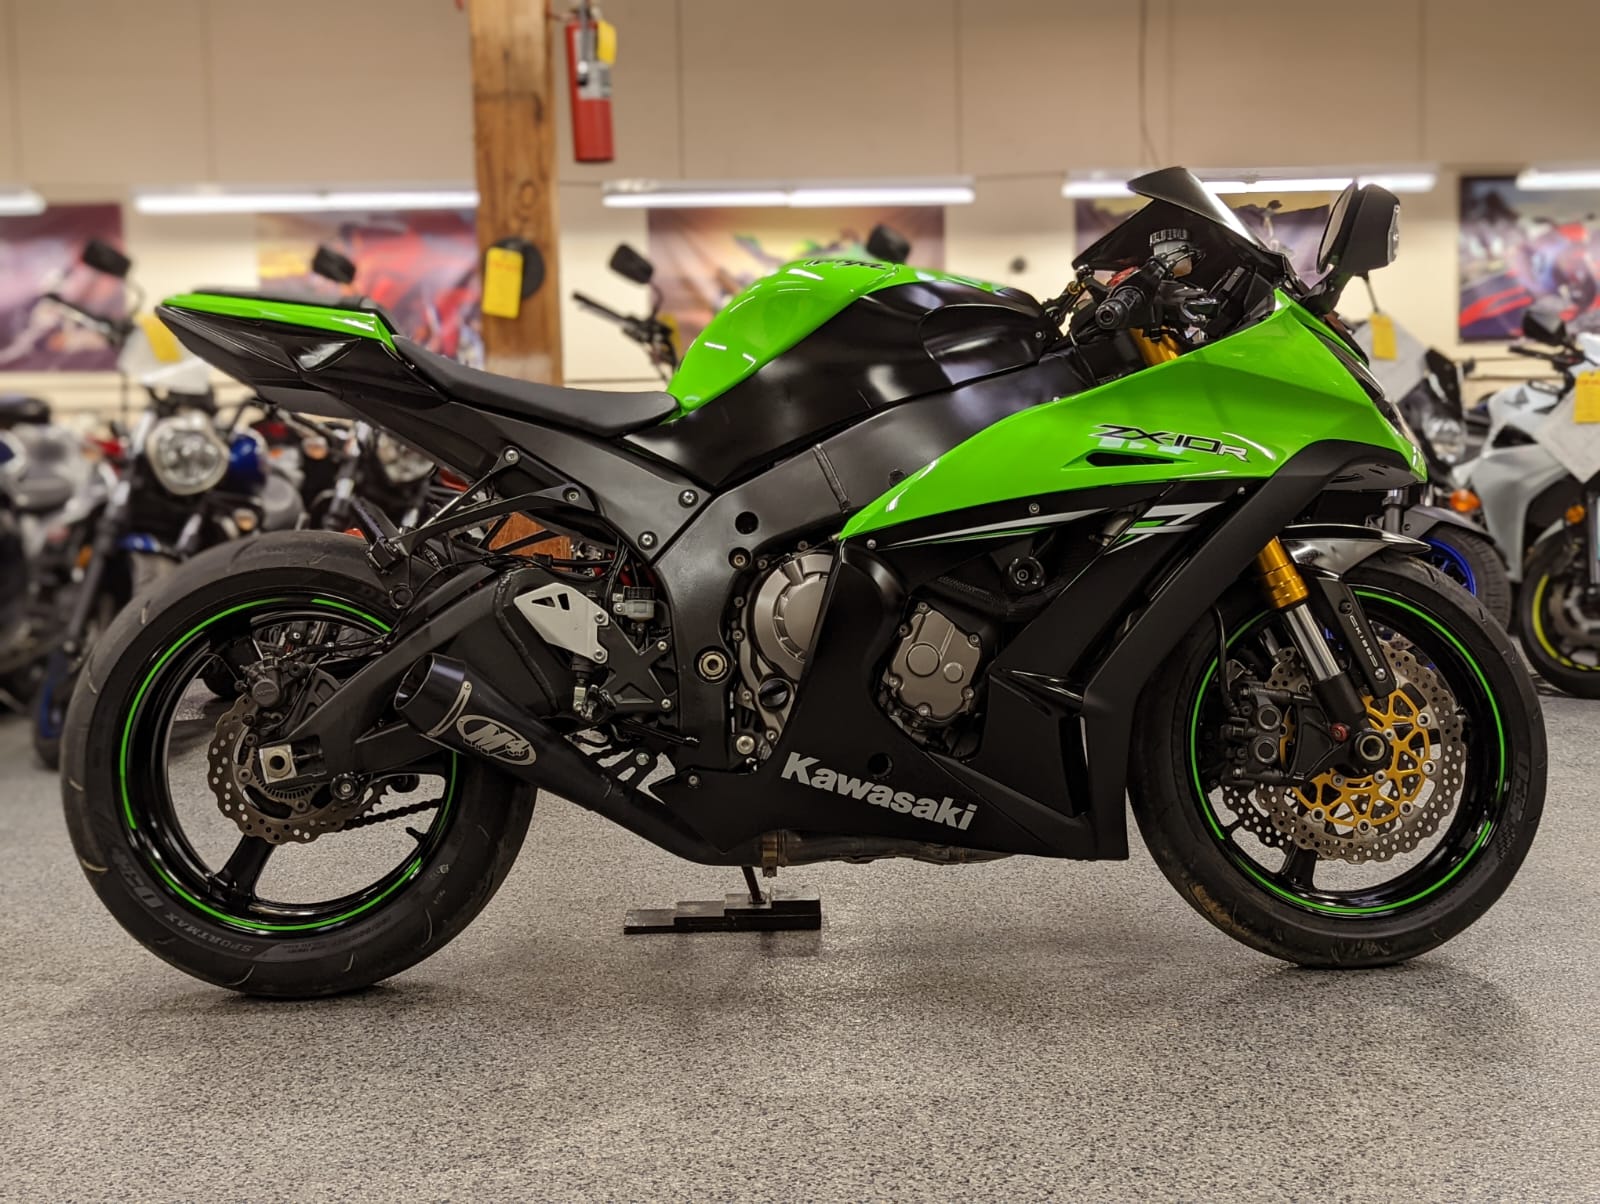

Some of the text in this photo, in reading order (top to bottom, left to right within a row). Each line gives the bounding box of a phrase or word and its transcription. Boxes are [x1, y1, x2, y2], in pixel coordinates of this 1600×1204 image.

[1088, 423, 1250, 462] ZX-10R
[780, 751, 978, 831] Kawasaki
[165, 911, 254, 953] SPORTMAX
